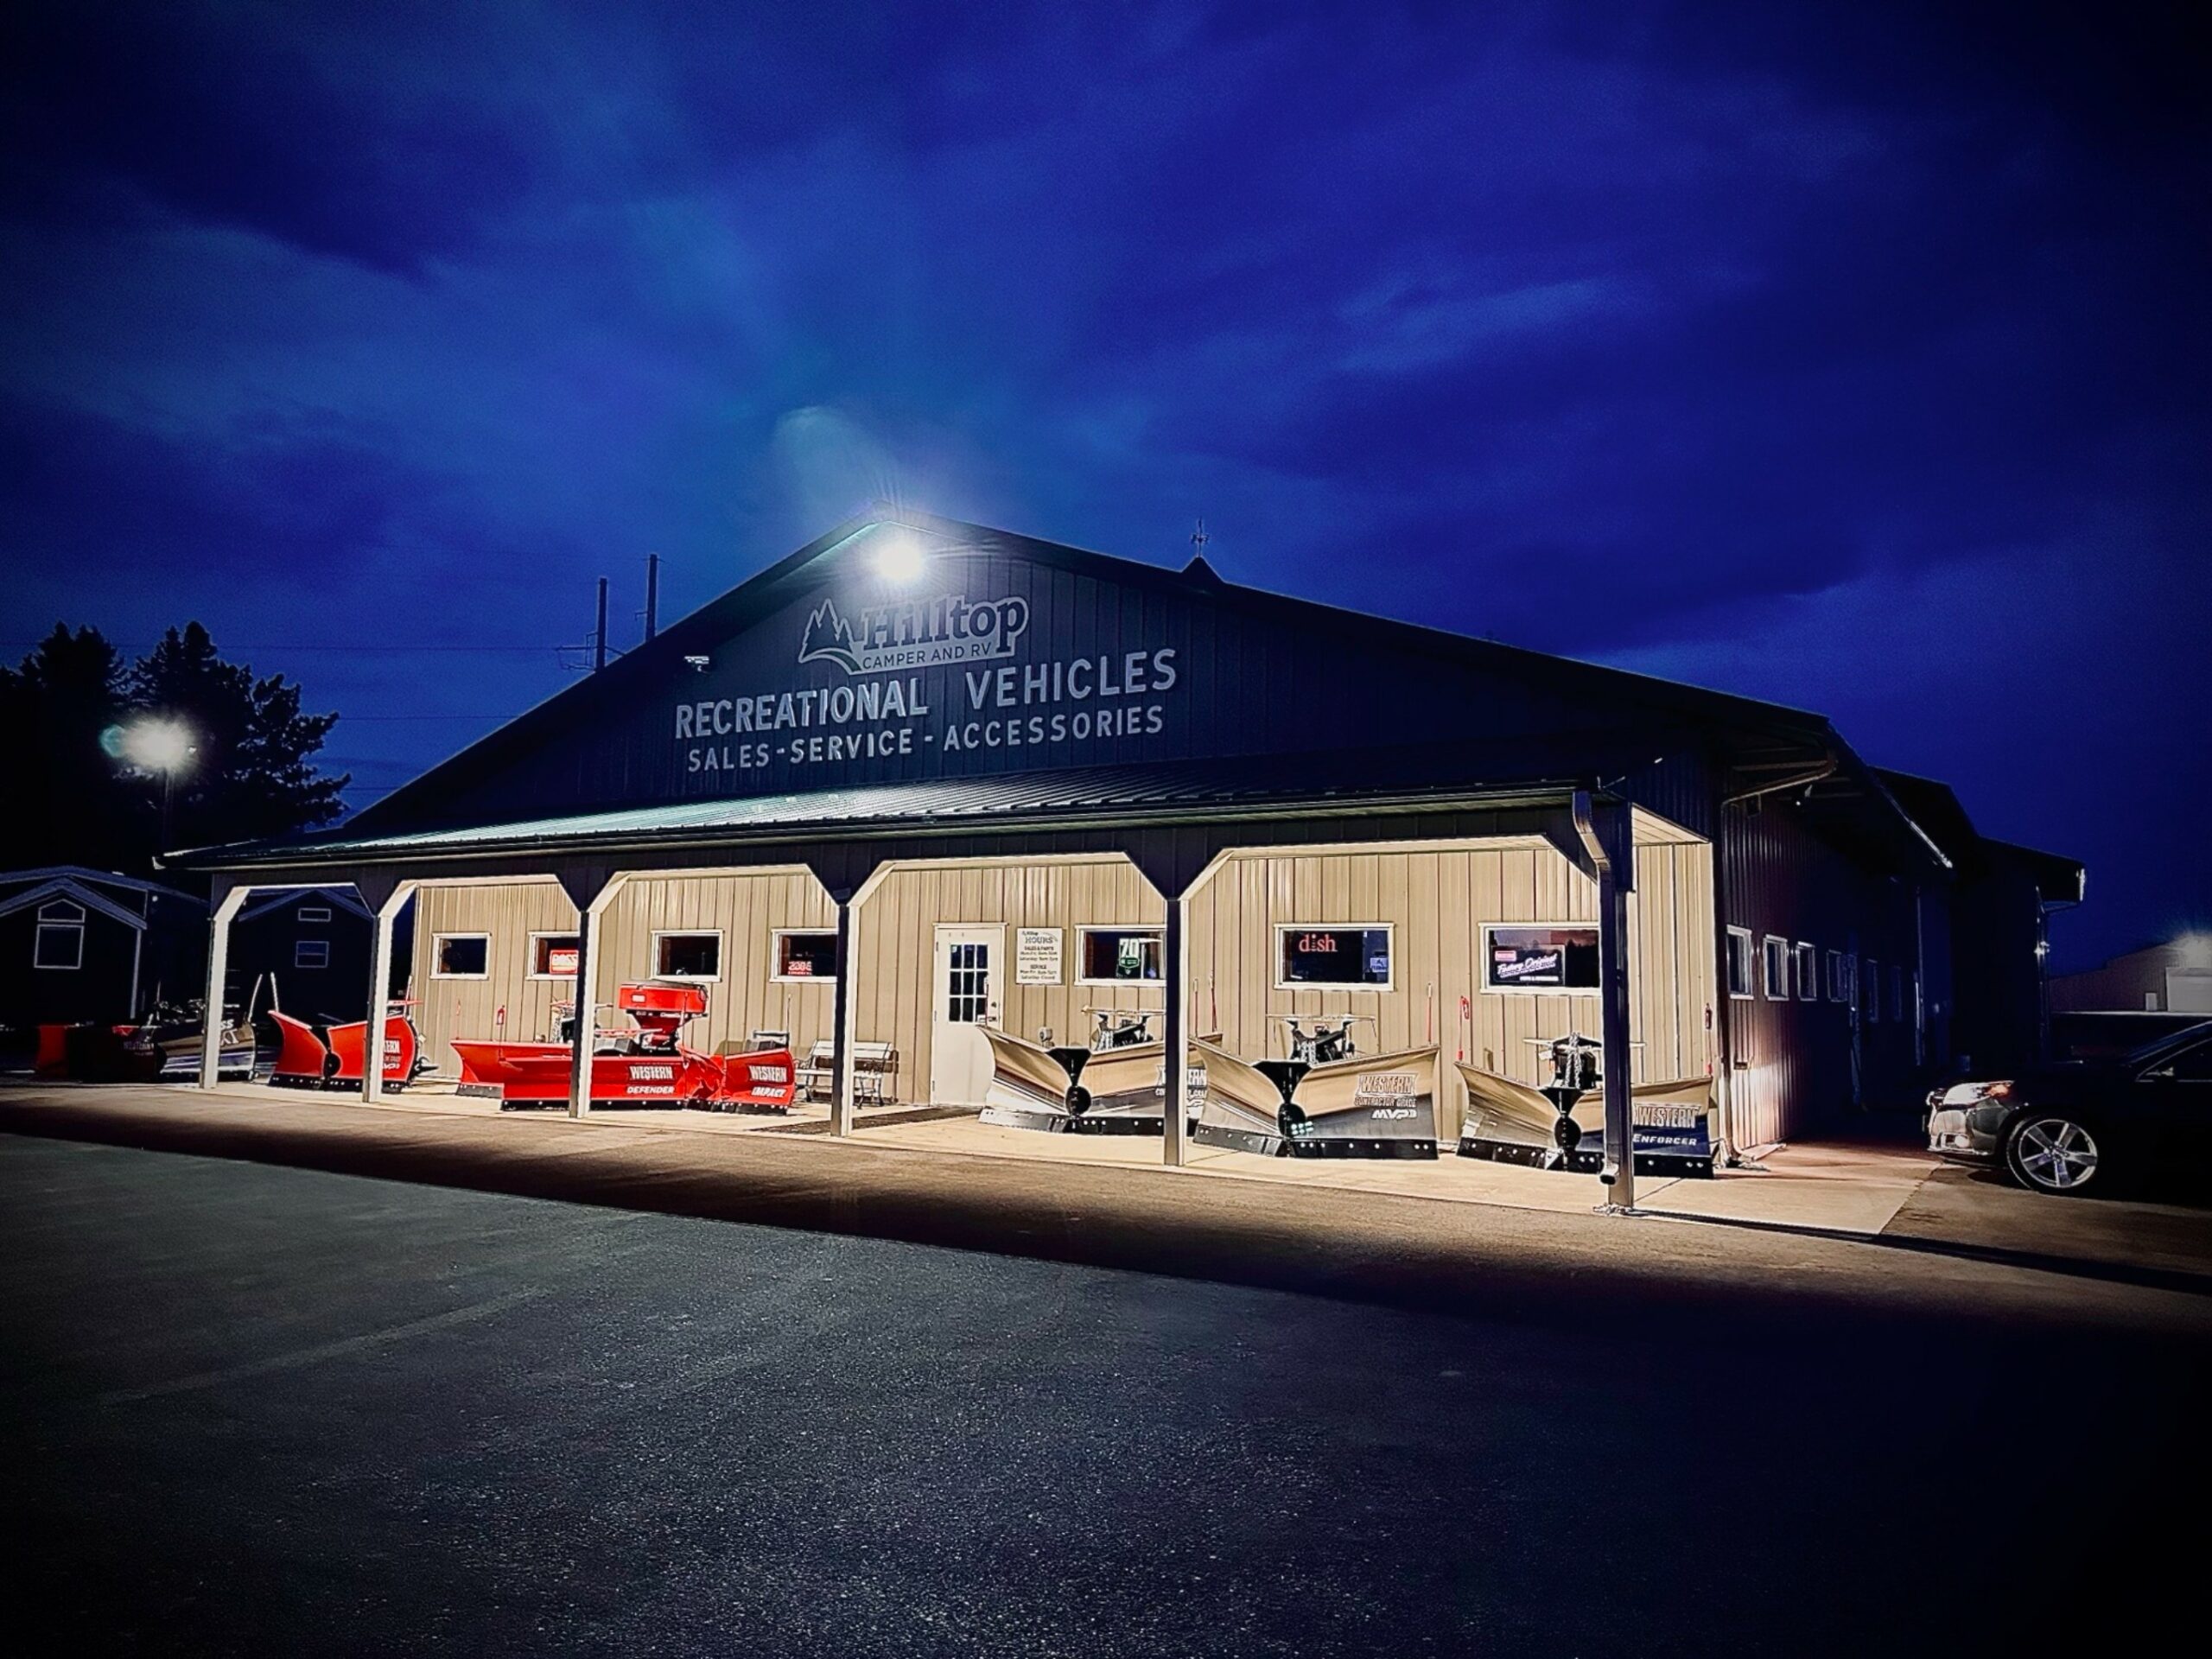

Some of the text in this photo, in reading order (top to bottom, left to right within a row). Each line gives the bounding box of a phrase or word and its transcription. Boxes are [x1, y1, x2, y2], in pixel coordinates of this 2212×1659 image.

[863, 596, 1026, 654] Hilltop
[862, 642, 992, 670] CAMPER AND RV
[676, 648, 1176, 739] RECREATIONAL VEHICLES
[944, 705, 1163, 752] ACCESSORIES
[1299, 933, 1338, 952] dish
[629, 1065, 673, 1080] WESTERN
[626, 1085, 675, 1095] DEFENDER
[1361, 1075, 1413, 1095] WESTERN
[1637, 1106, 1695, 1128] WESTERN
[1632, 1134, 1697, 1146] ENFORCER
